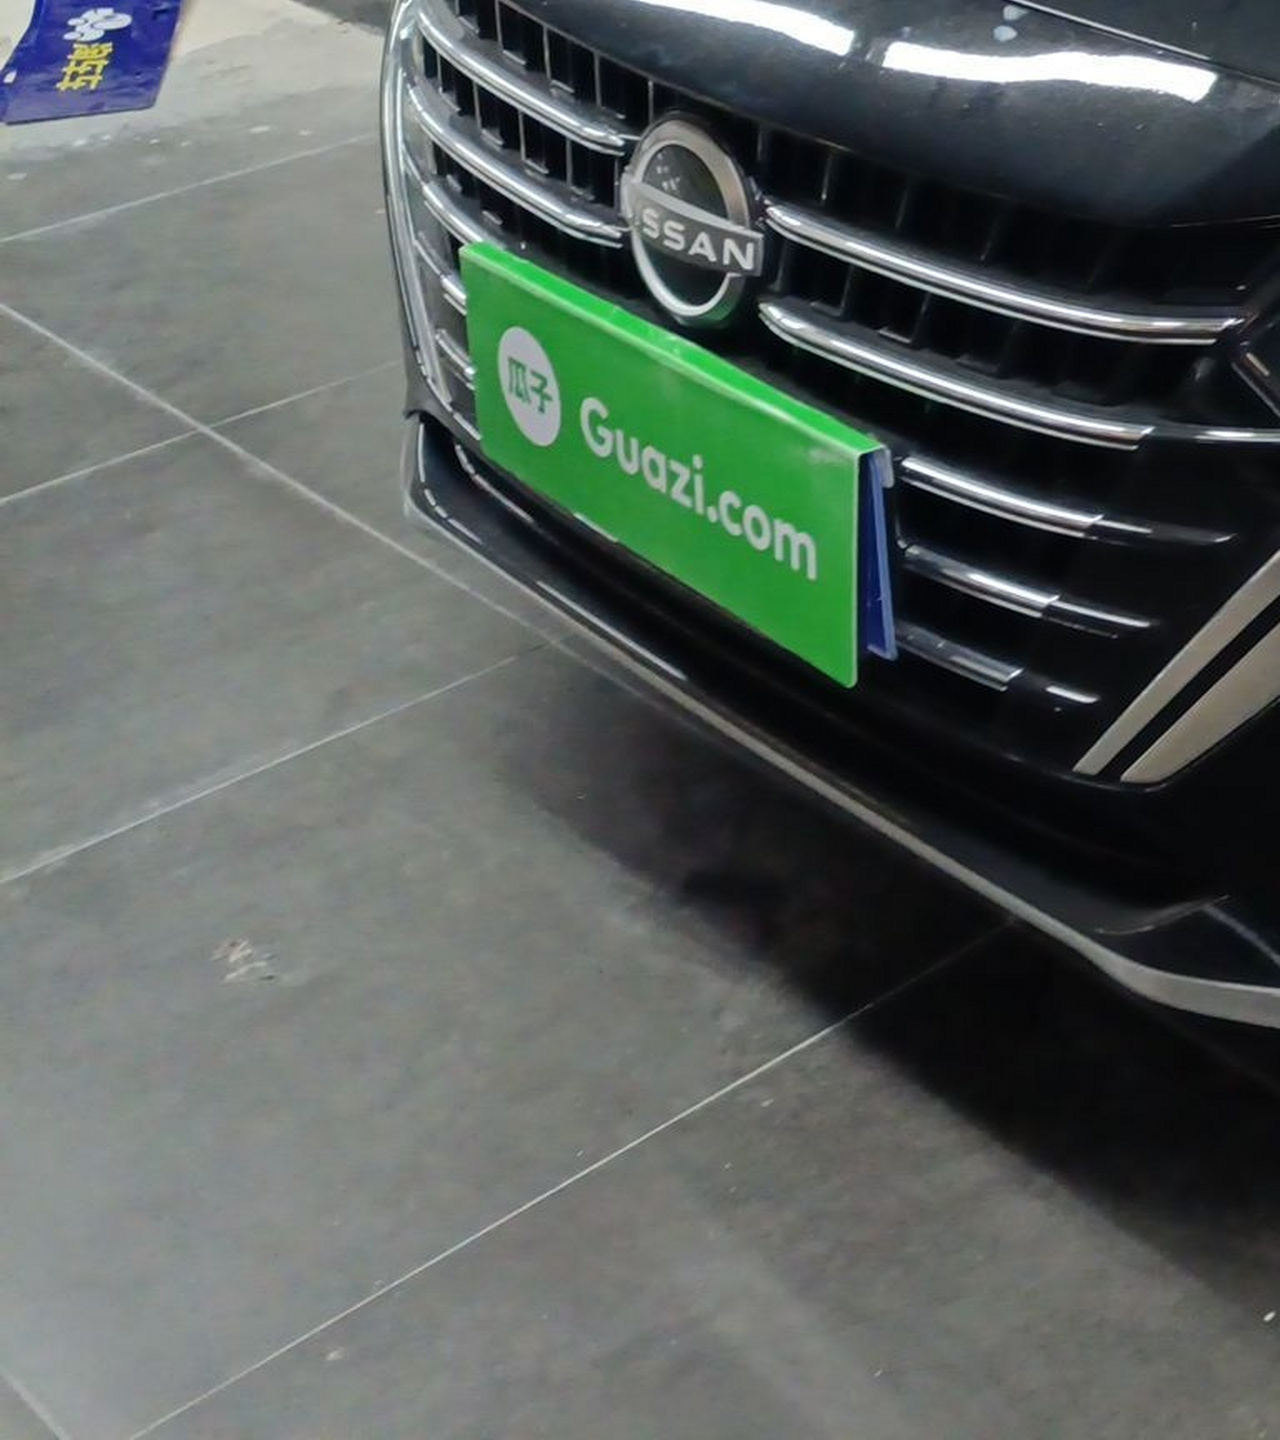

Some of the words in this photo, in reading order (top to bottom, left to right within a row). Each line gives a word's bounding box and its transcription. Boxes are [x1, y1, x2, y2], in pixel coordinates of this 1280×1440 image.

[632, 206, 755, 271] SSAN
[507, 356, 554, 415] 瓜子
[579, 396, 818, 581] Guazi.com
